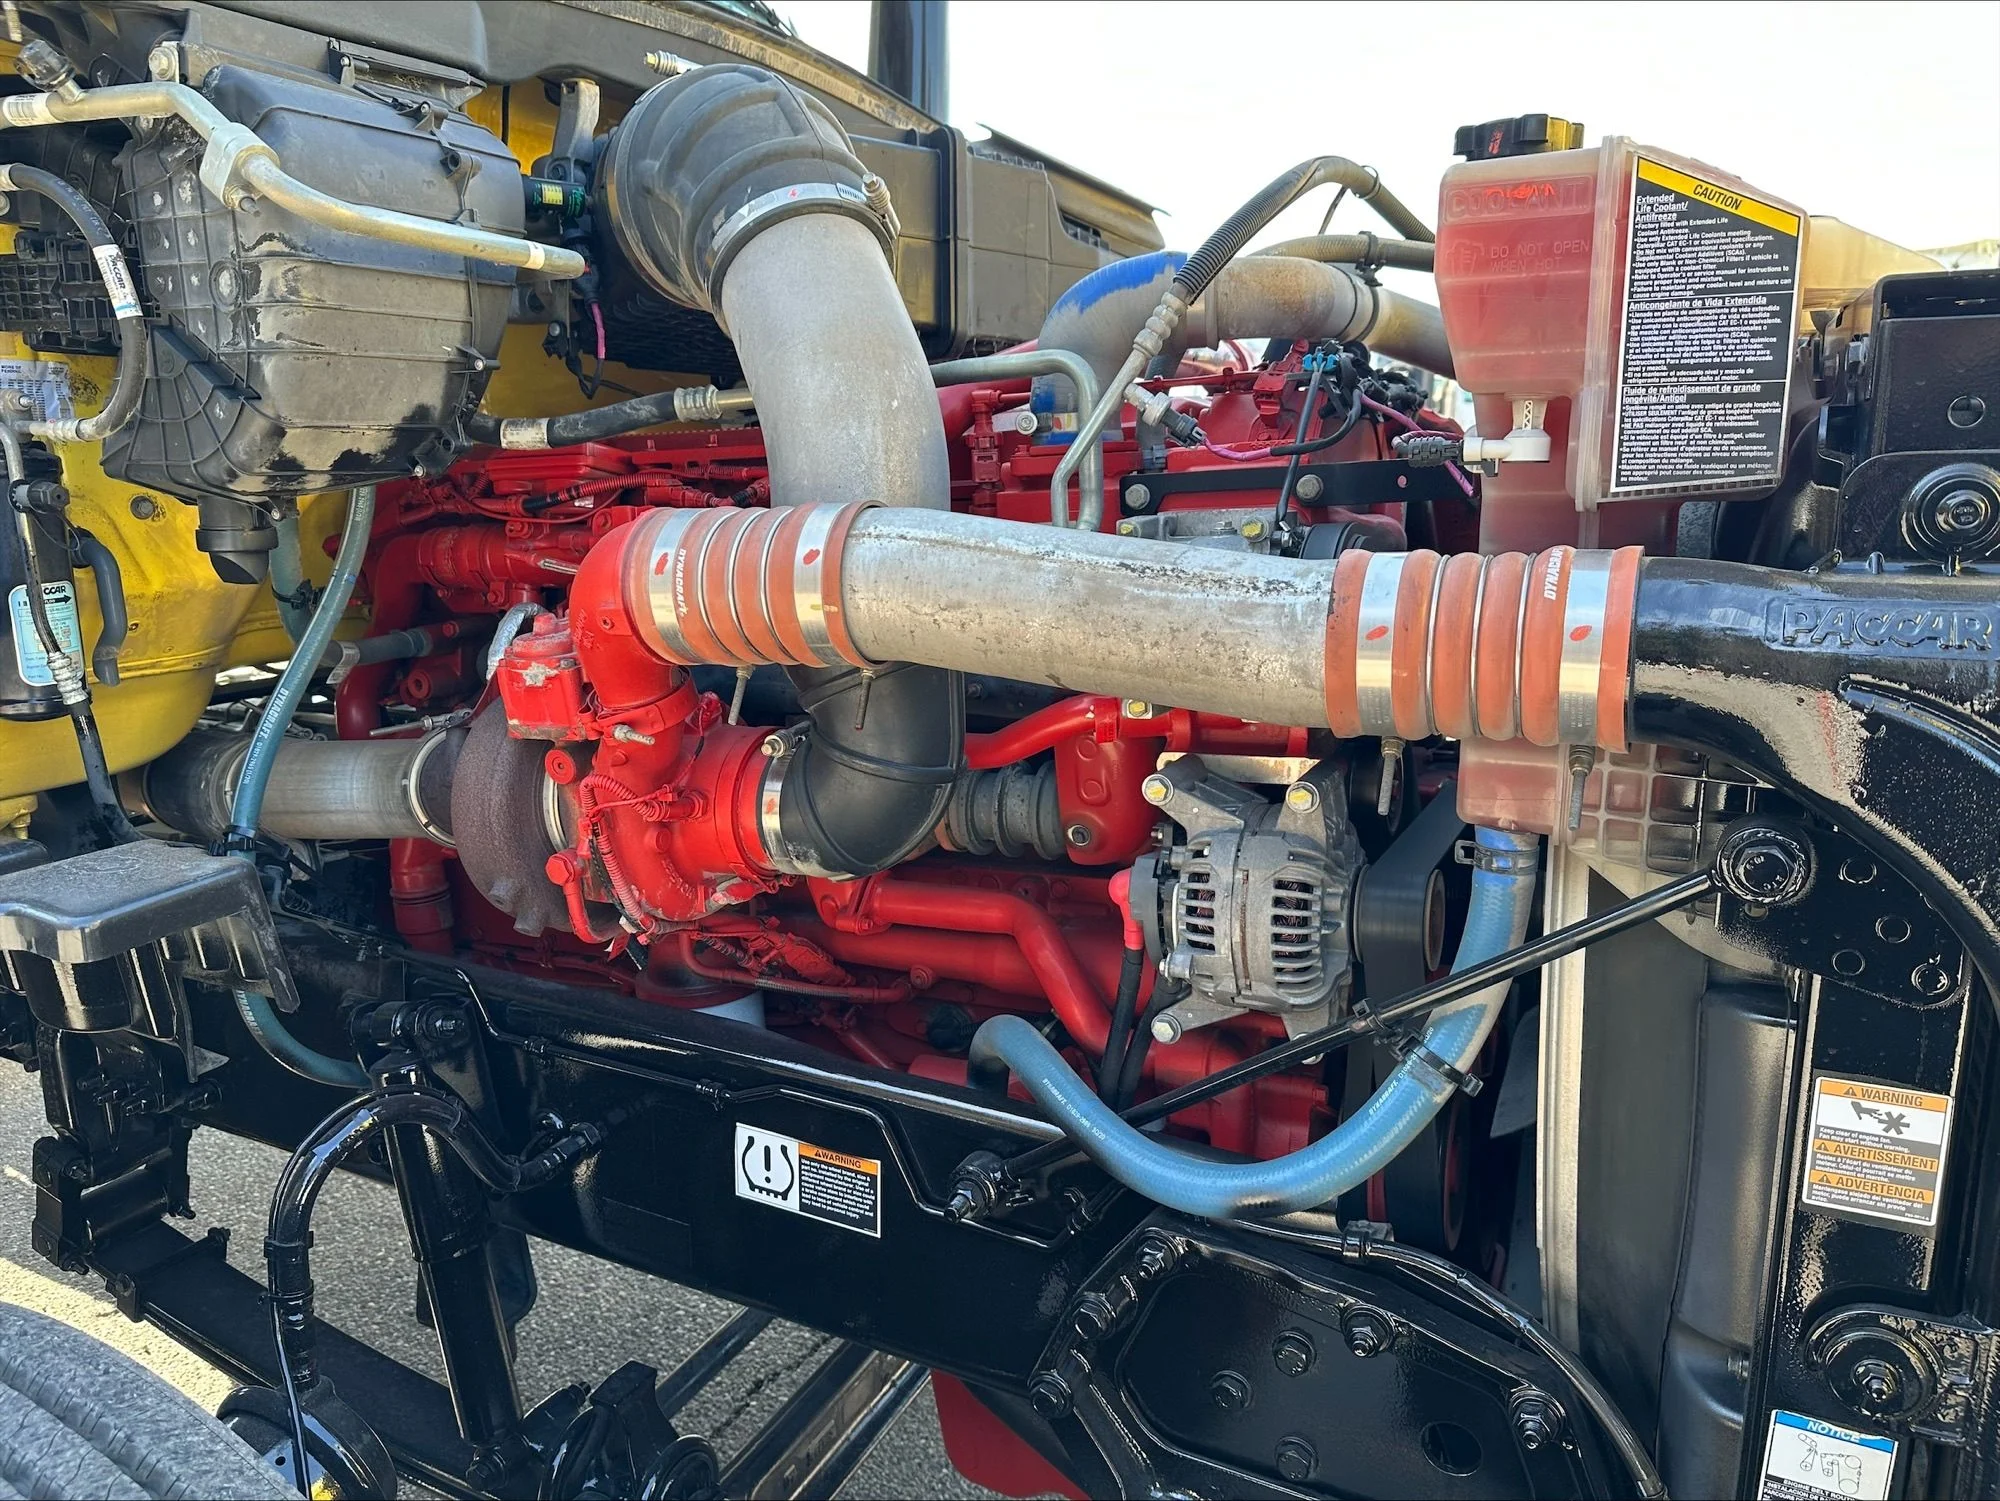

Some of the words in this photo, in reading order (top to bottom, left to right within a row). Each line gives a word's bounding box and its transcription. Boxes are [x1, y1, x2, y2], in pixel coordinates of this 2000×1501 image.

[1447, 183, 1585, 217] COOLANT
[1637, 194, 1674, 204] Extended
[1693, 184, 1742, 210] CAUTION
[1636, 204, 1652, 213] Life
[1653, 202, 1688, 213] Coolant/
[1636, 212, 1677, 222] Antifreeze
[1638, 222, 1659, 230] Factory
[1727, 230, 1751, 238] meeting
[1491, 245, 1509, 258] DO
[1518, 242, 1544, 255] NOT
[1553, 240, 1591, 254] OPEN
[109, 255, 126, 289] PACCAR
[1491, 259, 1527, 272] WHEN
[1536, 257, 1562, 270] HOT
[1629, 300, 1690, 311] Anticongelante
[1693, 299, 1702, 307] de
[1704, 298, 1723, 306] Vida
[1725, 296, 1767, 305] Extendida
[1624, 387, 1646, 395] Fluide
[1659, 385, 1720, 394] refroidissement
[1733, 384, 1761, 393] grande
[1783, 603, 1992, 650] PACCAR
[1861, 1088, 1923, 1107] WARNING
[822, 1151, 861, 1169] WARNING
[1834, 1144, 1936, 1170] AVERTISSEMENT
[1836, 1176, 1925, 1201] ADVERTENCIA
[1806, 1421, 1860, 1443] NOTICE
[1783, 1480, 1810, 1491] ENGINE
[1811, 1487, 1829, 1496] BELT
